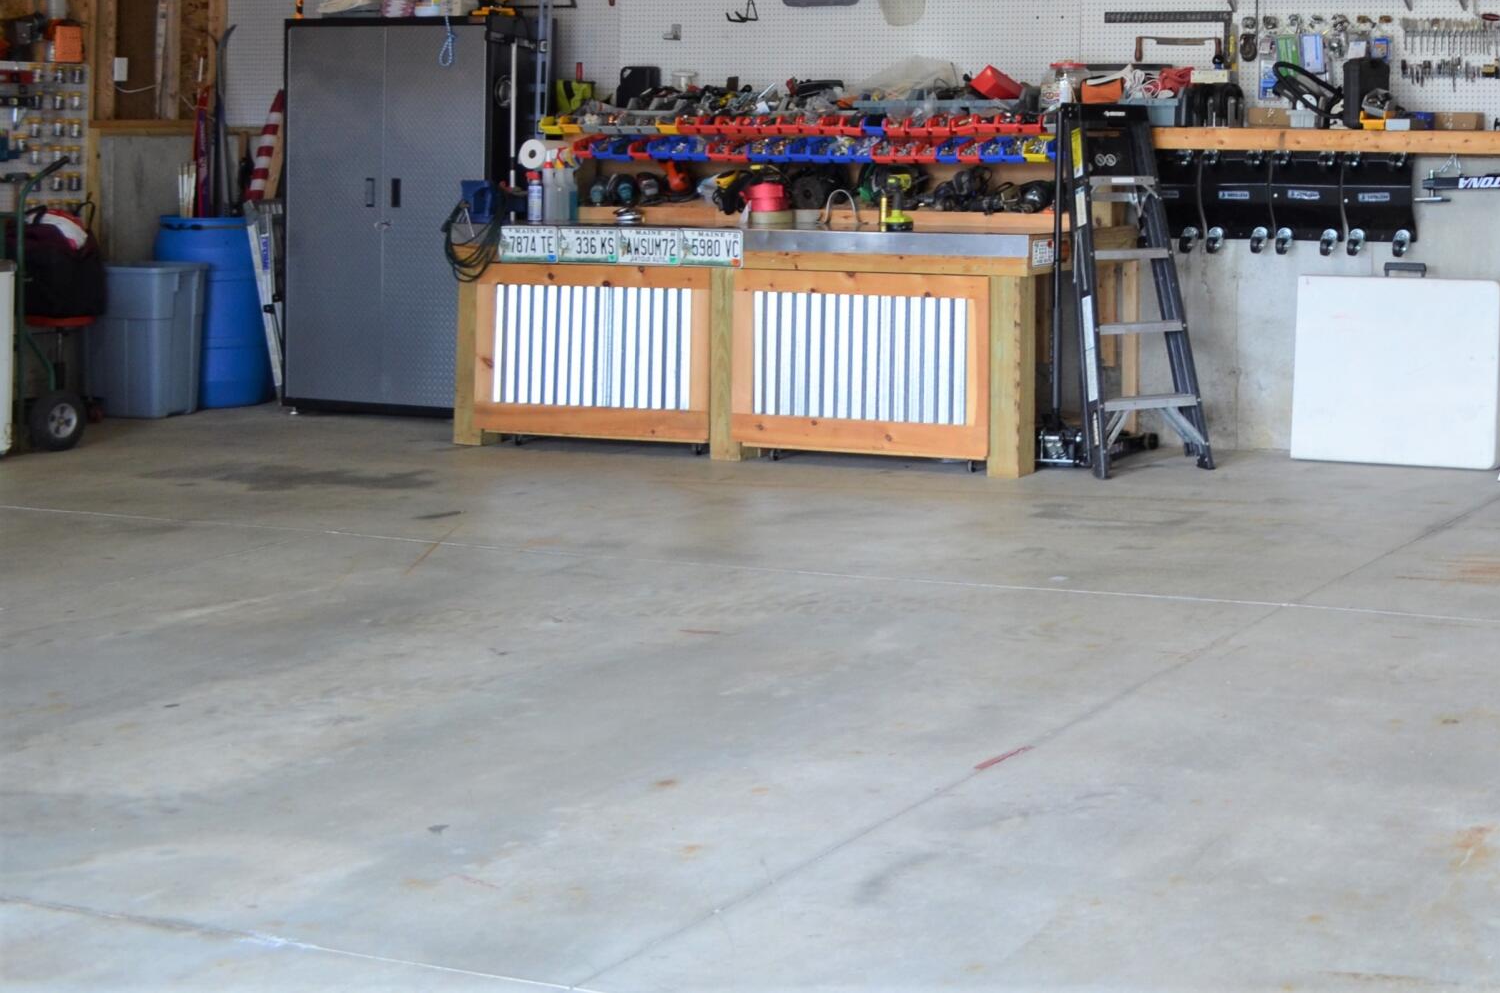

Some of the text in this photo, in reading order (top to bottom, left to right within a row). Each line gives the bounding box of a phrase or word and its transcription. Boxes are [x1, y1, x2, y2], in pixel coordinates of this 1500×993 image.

[509, 236, 555, 254] 7874 TE
[576, 237, 615, 255] 336 KS
[626, 238, 676, 257] AWSUM72
[691, 239, 740, 258] 5980 VC
